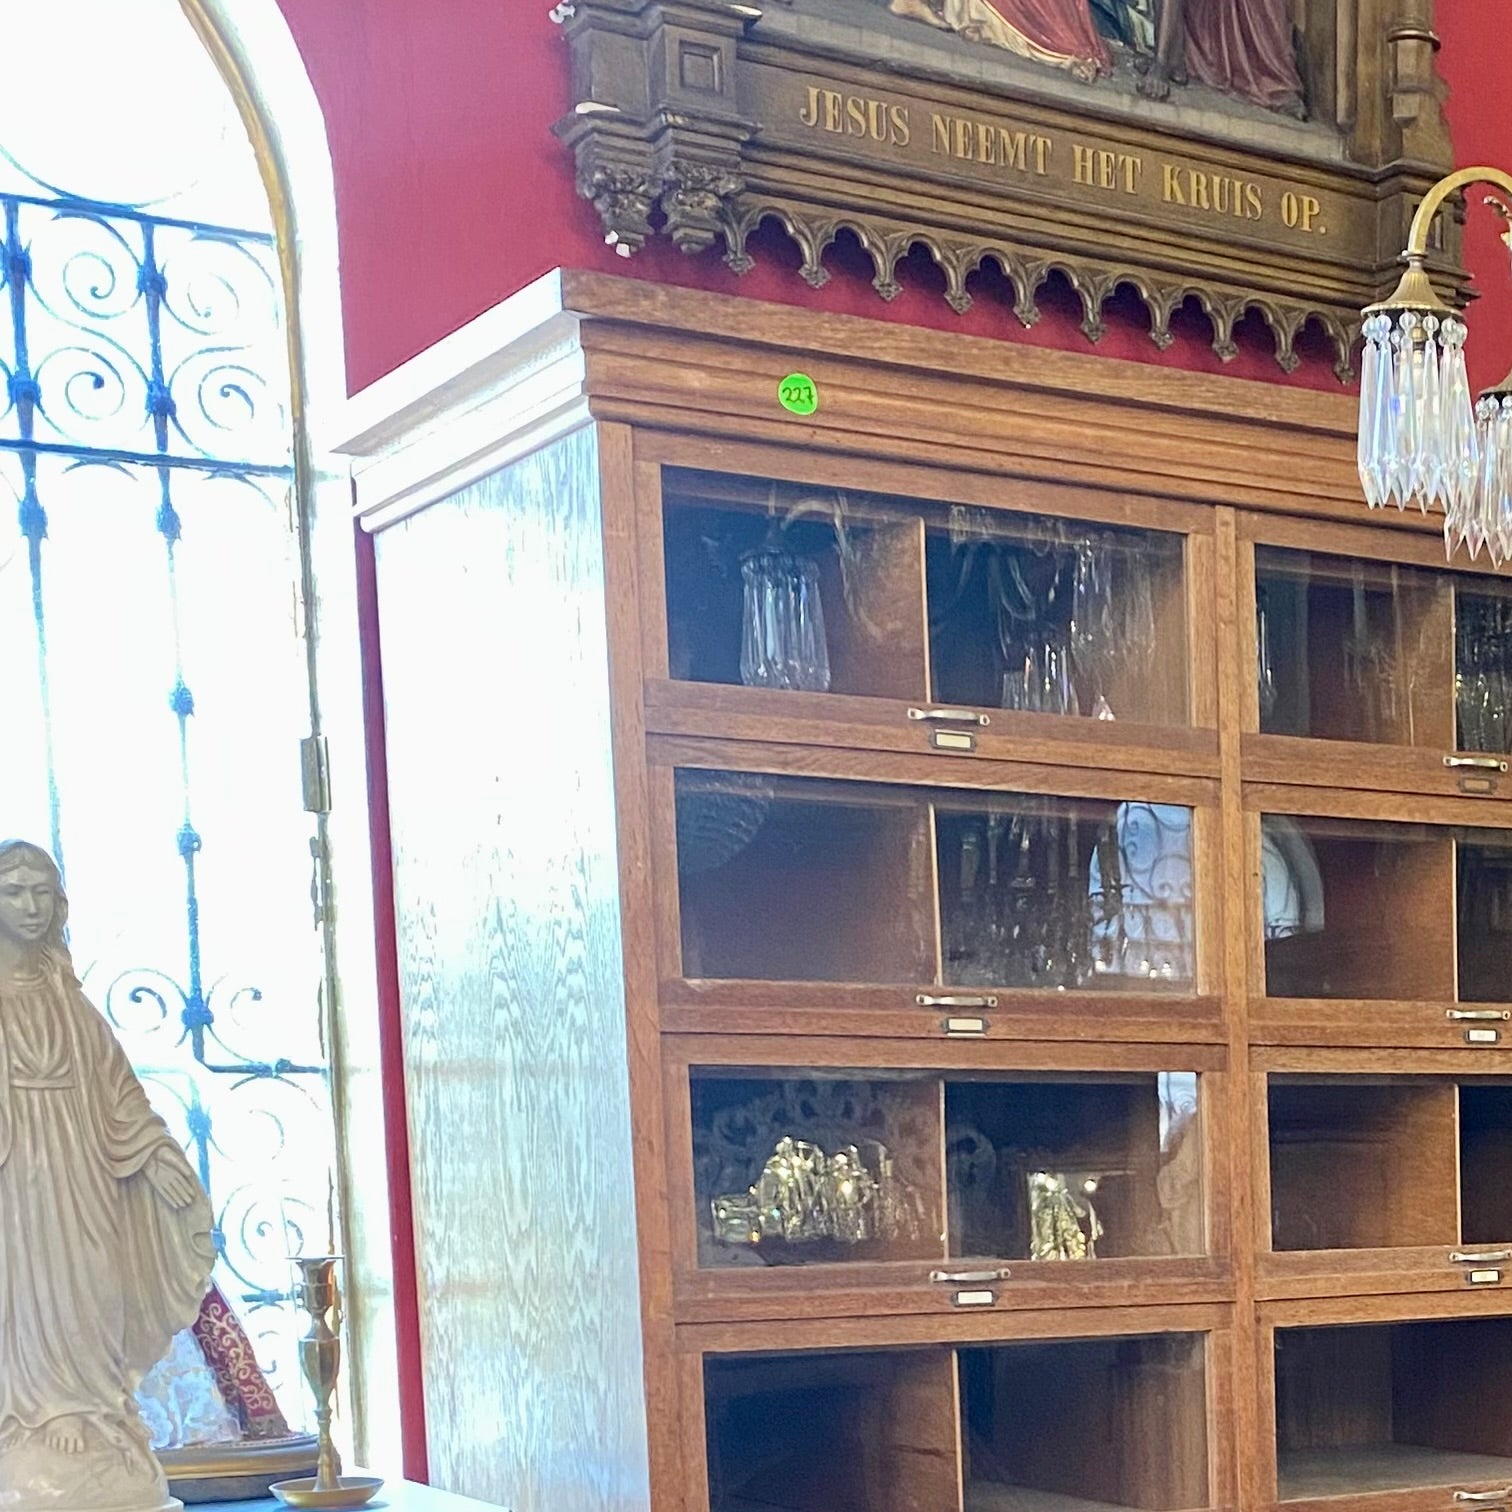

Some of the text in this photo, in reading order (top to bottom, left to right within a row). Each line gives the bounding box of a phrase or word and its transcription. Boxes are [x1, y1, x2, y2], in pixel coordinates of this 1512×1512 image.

[800, 86, 1328, 235] JESUS NEEMT HET KRUIS OP.
[782, 386, 814, 405] 227
